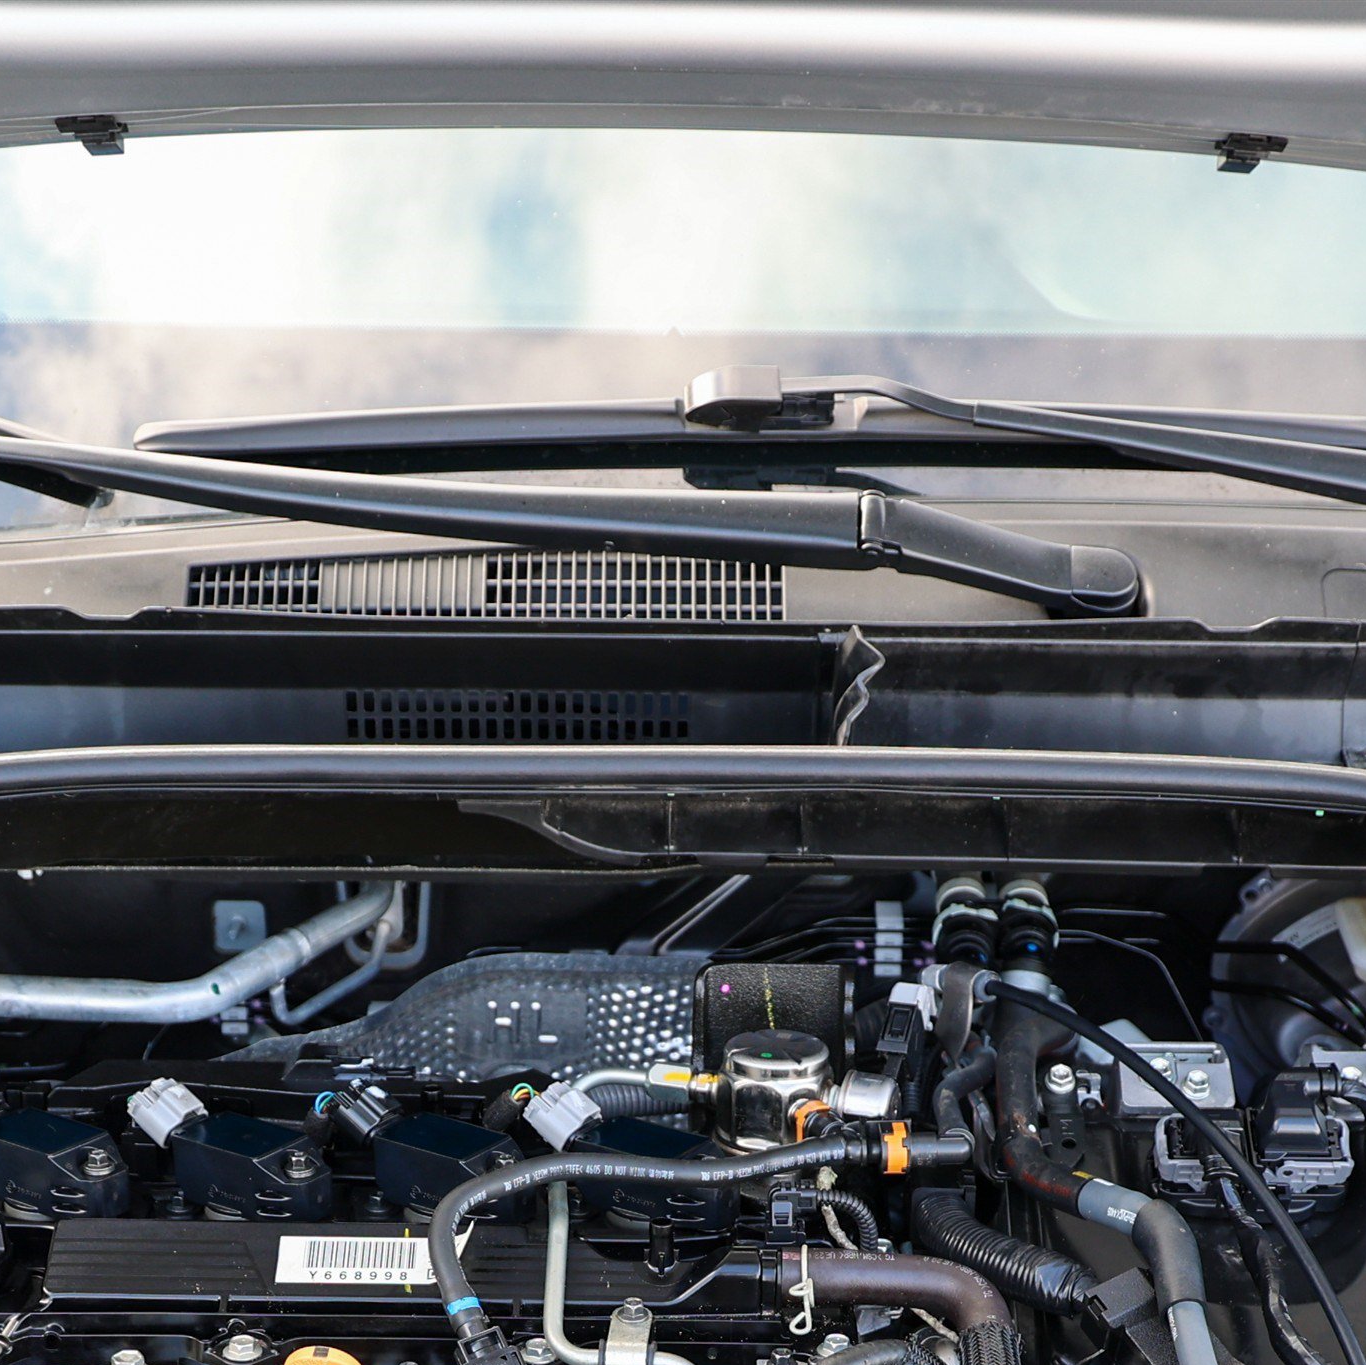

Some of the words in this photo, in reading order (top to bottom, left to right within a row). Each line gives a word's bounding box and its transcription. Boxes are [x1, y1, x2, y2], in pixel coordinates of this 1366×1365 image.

[604, 1165, 613, 1176] DO
[614, 1165, 626, 1176] NOT
[309, 1271, 408, 1281] Y668998
